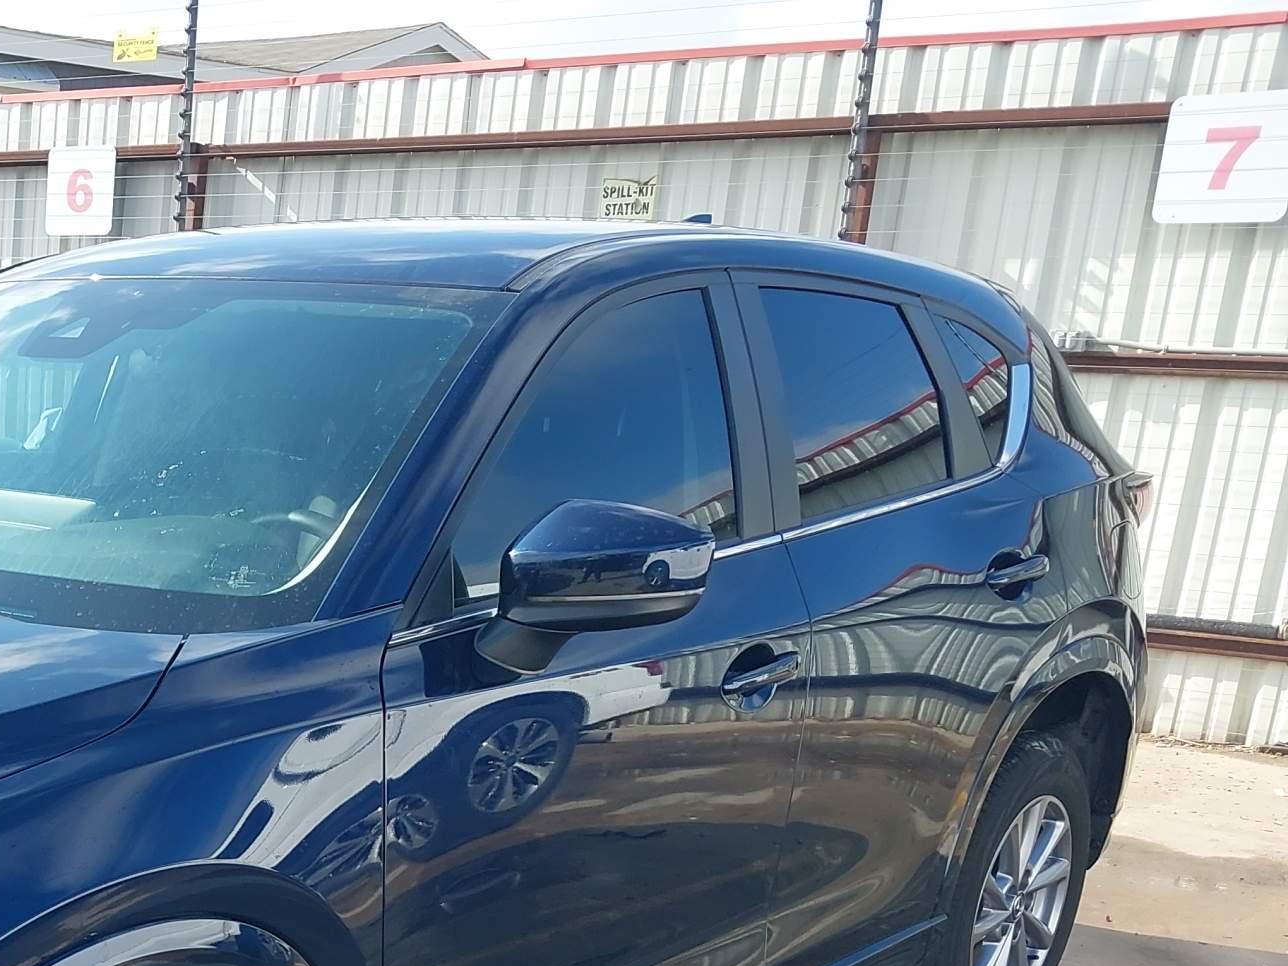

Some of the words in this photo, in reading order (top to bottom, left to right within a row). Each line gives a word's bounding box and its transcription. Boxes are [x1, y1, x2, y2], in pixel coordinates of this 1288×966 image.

[1206, 125, 1263, 190] 7
[66, 168, 94, 213] 6
[602, 184, 656, 199] SPILL-KIT
